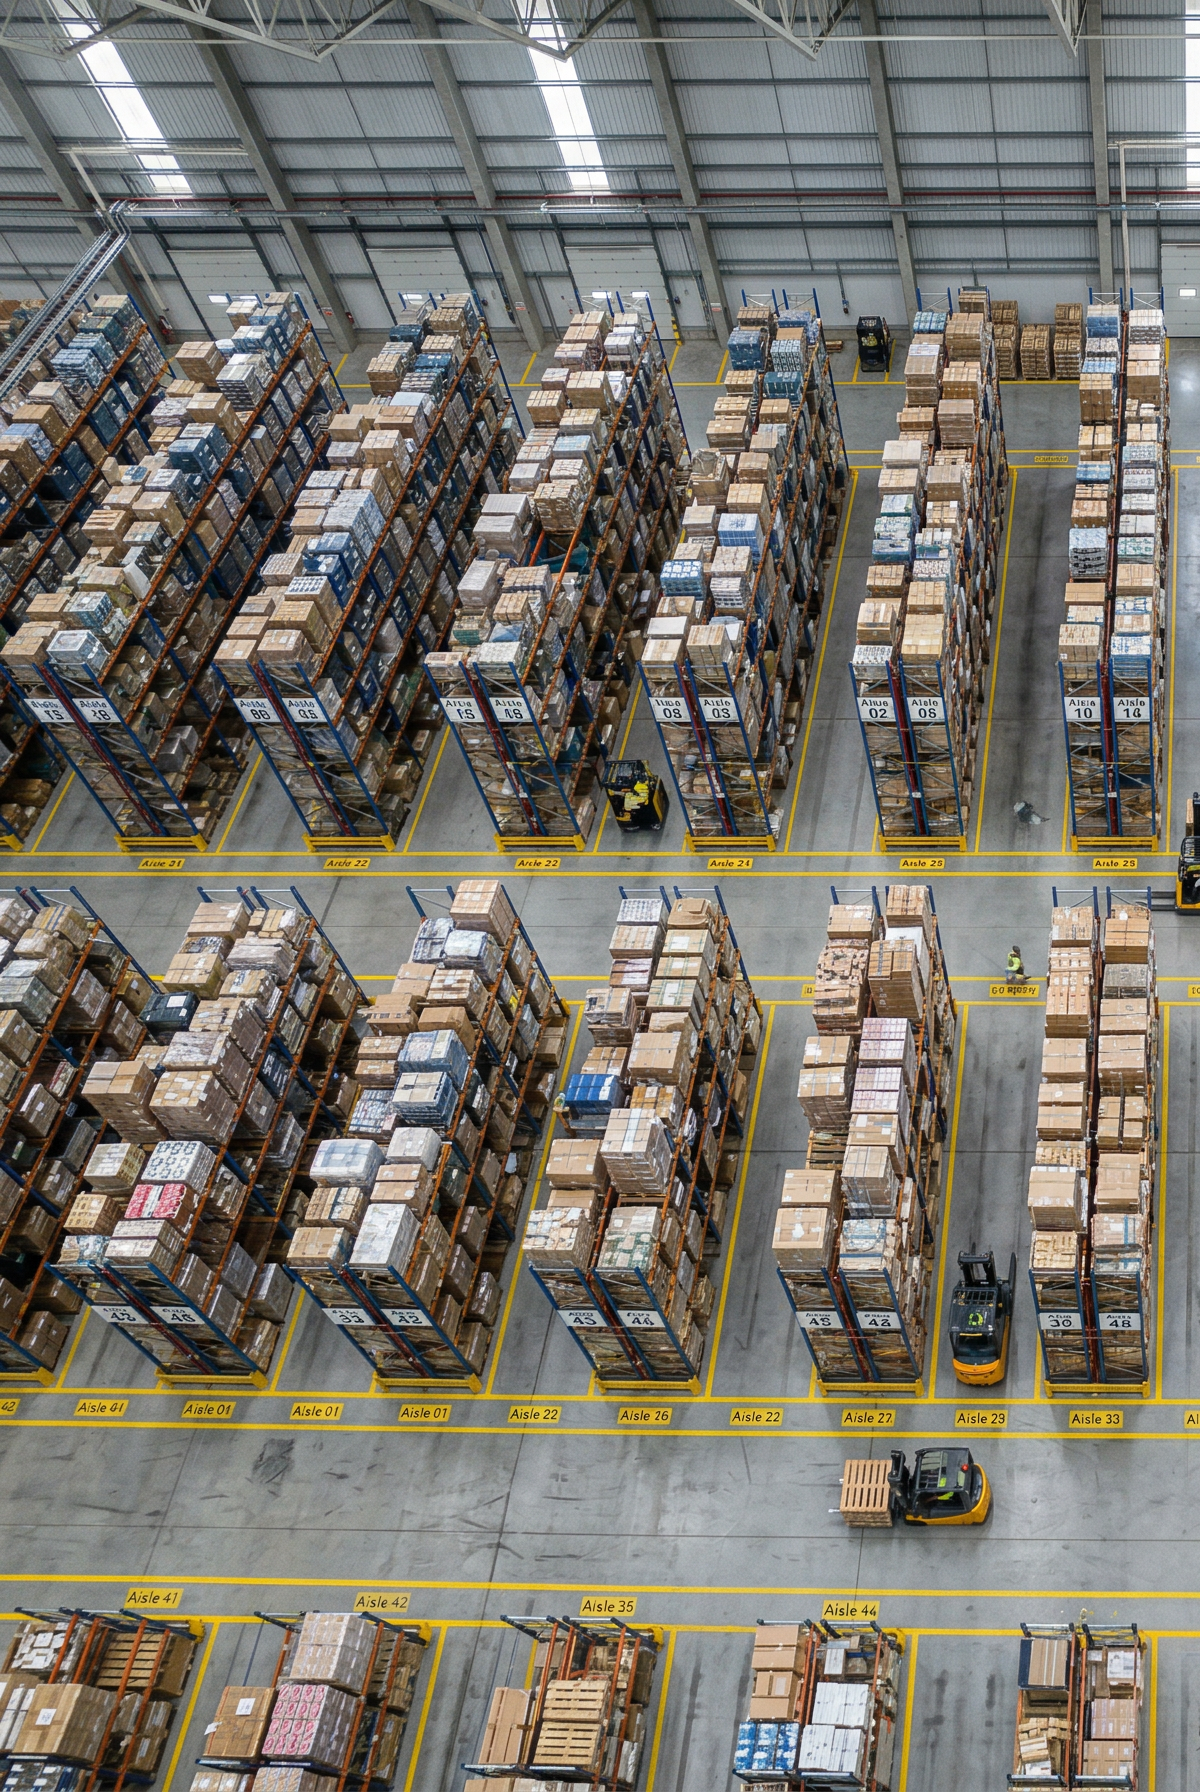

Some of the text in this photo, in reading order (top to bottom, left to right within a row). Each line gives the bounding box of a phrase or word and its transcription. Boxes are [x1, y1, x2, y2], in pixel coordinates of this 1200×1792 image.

[868, 708, 887, 719] 02
[1074, 708, 1093, 719] 10
[544, 859, 559, 868] 22
[1109, 1319, 1132, 1328] 48
[77, 1402, 107, 1413] Aisle
[183, 1402, 232, 1415] Aisle 01
[325, 1406, 339, 1417] 01
[400, 1407, 448, 1418] Aisle 01
[509, 1409, 558, 1420] Aisle 22
[620, 1410, 669, 1421] Aisle 26
[732, 1411, 781, 1422] Aisle 22
[843, 1411, 874, 1423] Aisle
[957, 1412, 988, 1424] Aisle
[1071, 1412, 1120, 1424] Aisle 33
[127, 1590, 178, 1604] Aisle 41
[357, 1596, 408, 1609] Aisle 42
[582, 1599, 634, 1613] Aisle 35
[824, 1603, 877, 1617] Aisle 44
